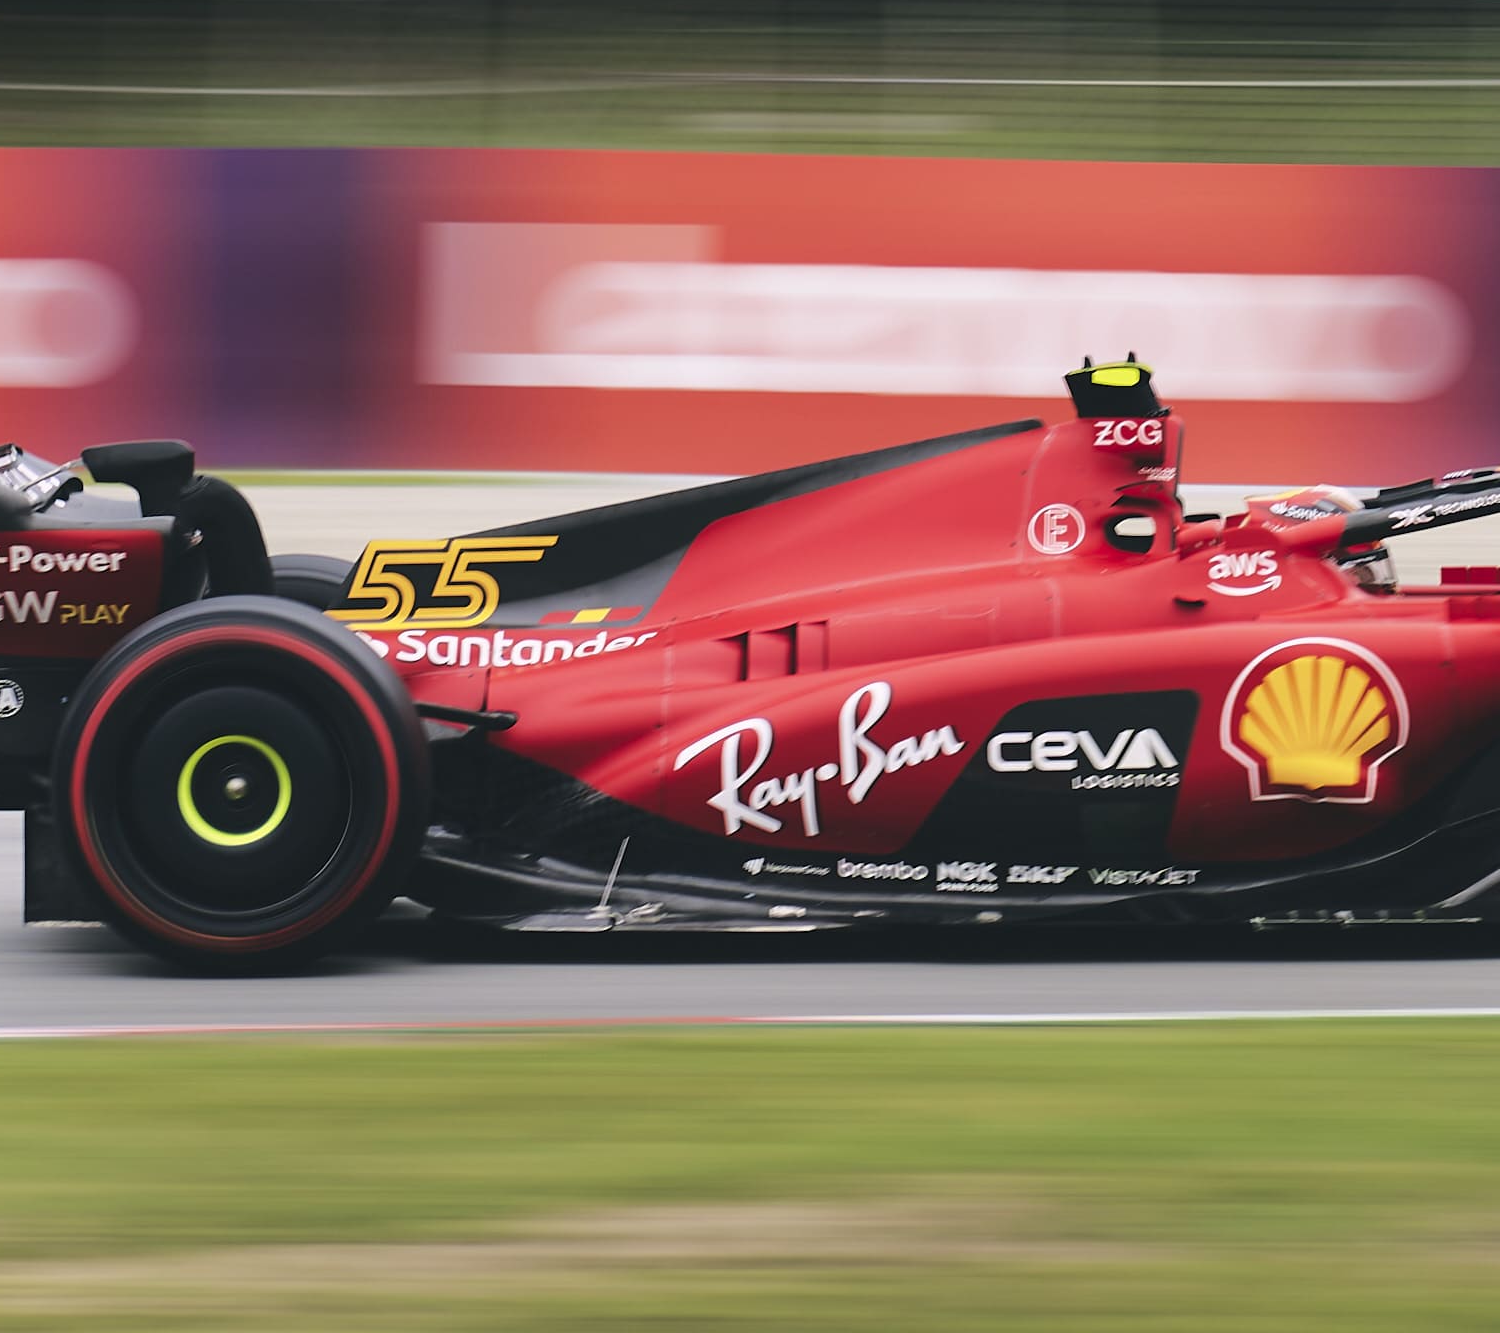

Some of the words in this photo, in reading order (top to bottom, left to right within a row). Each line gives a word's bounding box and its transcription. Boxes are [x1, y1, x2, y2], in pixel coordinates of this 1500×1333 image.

[1093, 419, 1163, 446] ZCG
[1208, 549, 1278, 579] aws
[323, 535, 560, 630] 55
[59, 603, 132, 625] PLAY
[396, 629, 658, 668] Santander
[1070, 772, 1181, 790] LOGISTICS
[836, 857, 930, 881] brembo
